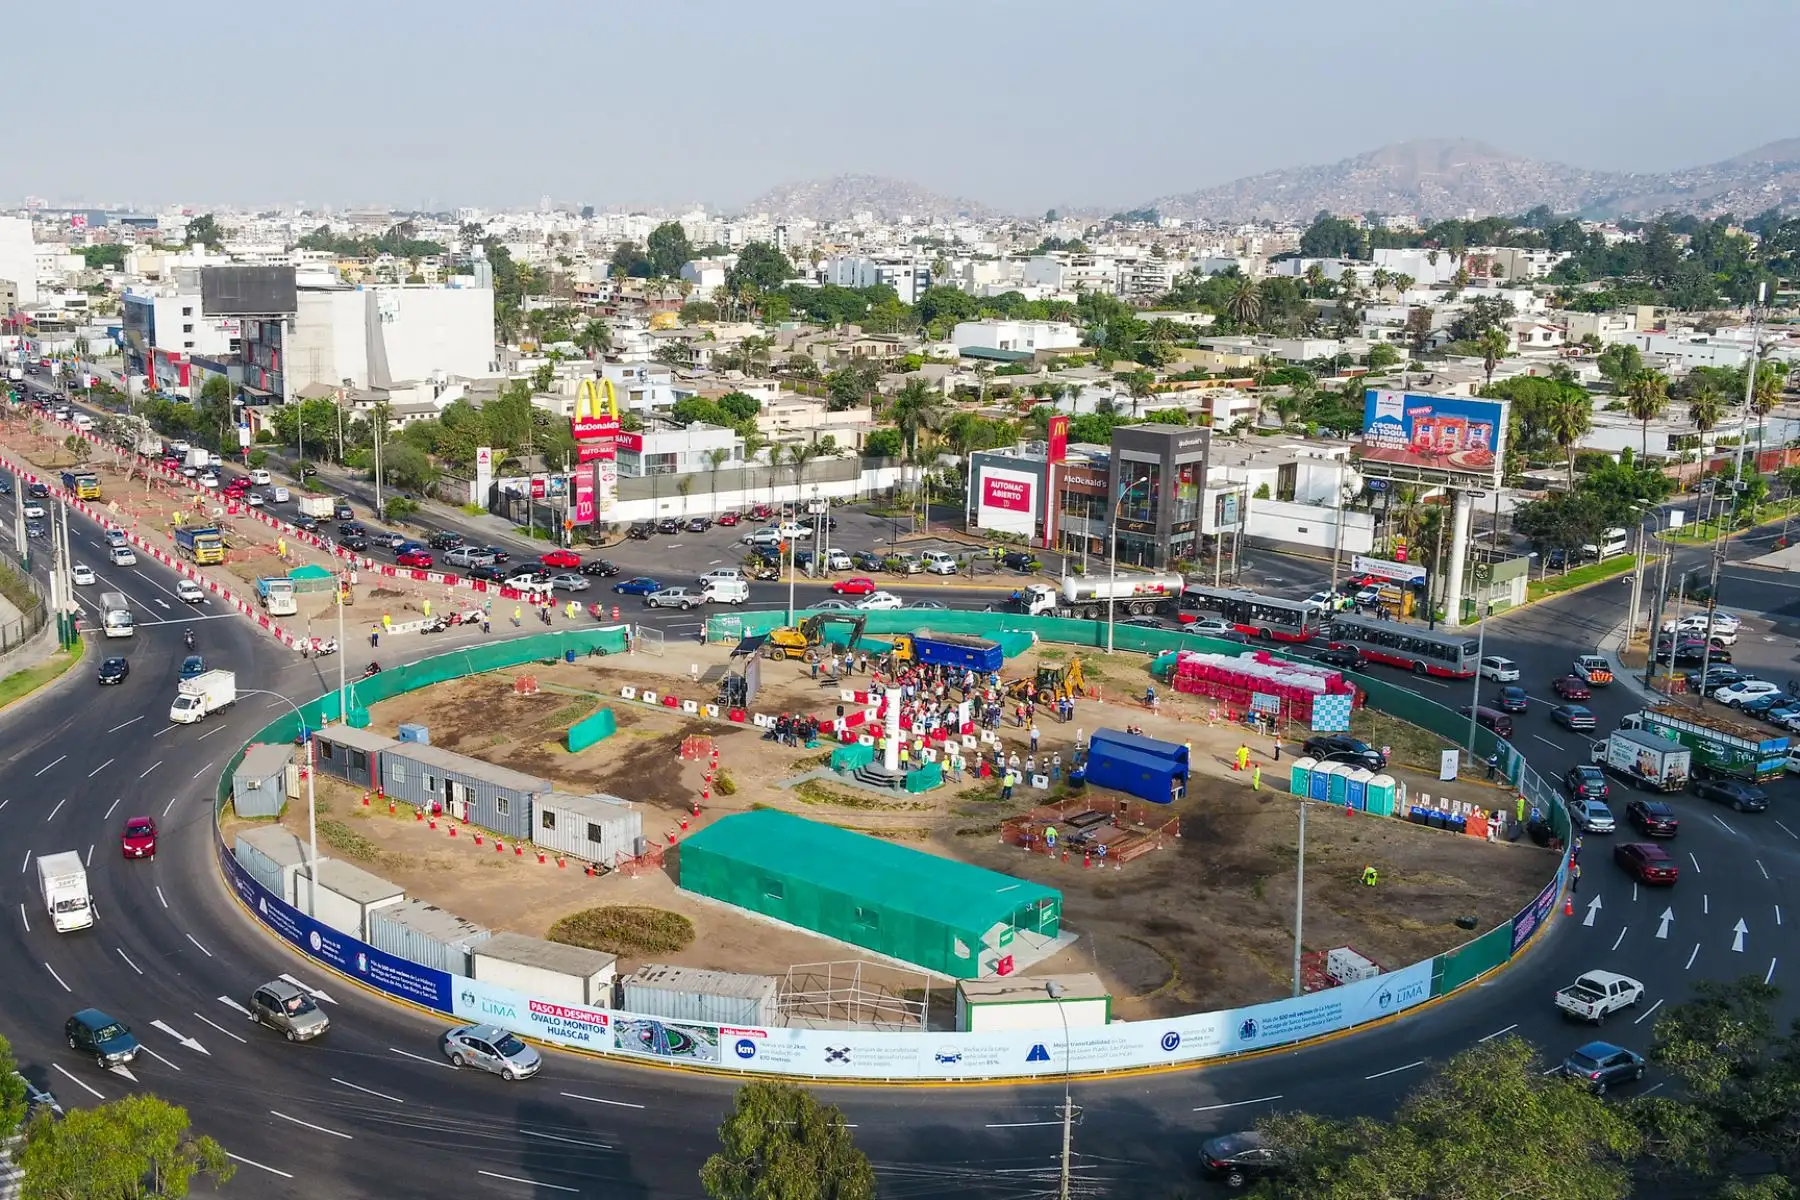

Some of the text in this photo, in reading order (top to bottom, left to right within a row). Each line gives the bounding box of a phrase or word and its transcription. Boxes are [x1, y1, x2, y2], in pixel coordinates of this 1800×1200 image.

[575, 422, 620, 431] McDonald's
[1372, 422, 1402, 431] COCINA
[1379, 429, 1406, 437] TOQUE
[581, 447, 614, 455] AUTO-MAC
[991, 481, 1024, 492] AUTOMAC
[1064, 475, 1106, 488] McDonald's
[992, 490, 1021, 500] ABIERTO
[1397, 986, 1422, 1003] LIMA
[482, 1002, 516, 1019] LIMA
[531, 1002, 606, 1025] PASO A DESNIVEL
[563, 1021, 606, 1035] MONITOR
[738, 1045, 753, 1054] km
